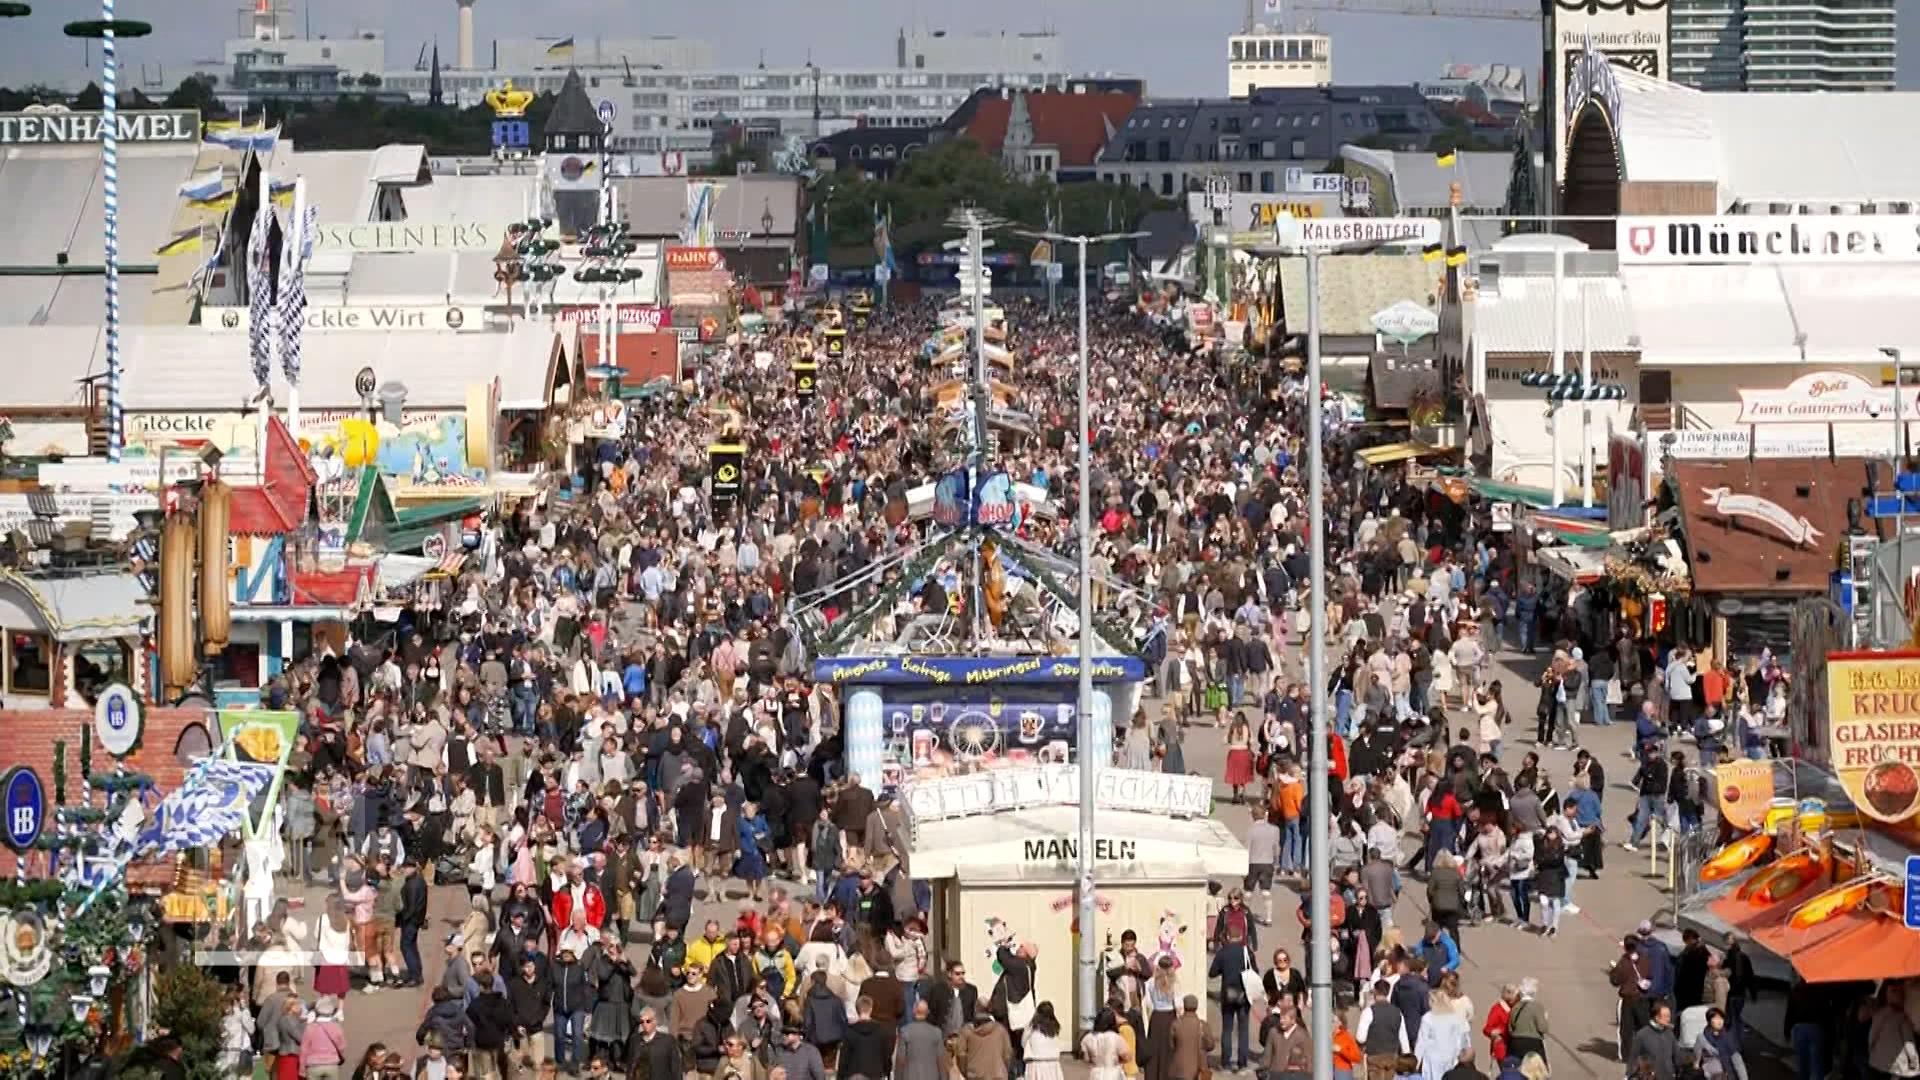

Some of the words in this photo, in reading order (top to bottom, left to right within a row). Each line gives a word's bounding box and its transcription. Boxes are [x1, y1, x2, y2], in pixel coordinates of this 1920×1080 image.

[302, 308, 360, 329] ckle
[370, 308, 424, 328] Wirt
[1053, 661, 1124, 676] Souenirs
[13, 807, 34, 835] HB
[1024, 839, 1136, 860] MANELN
